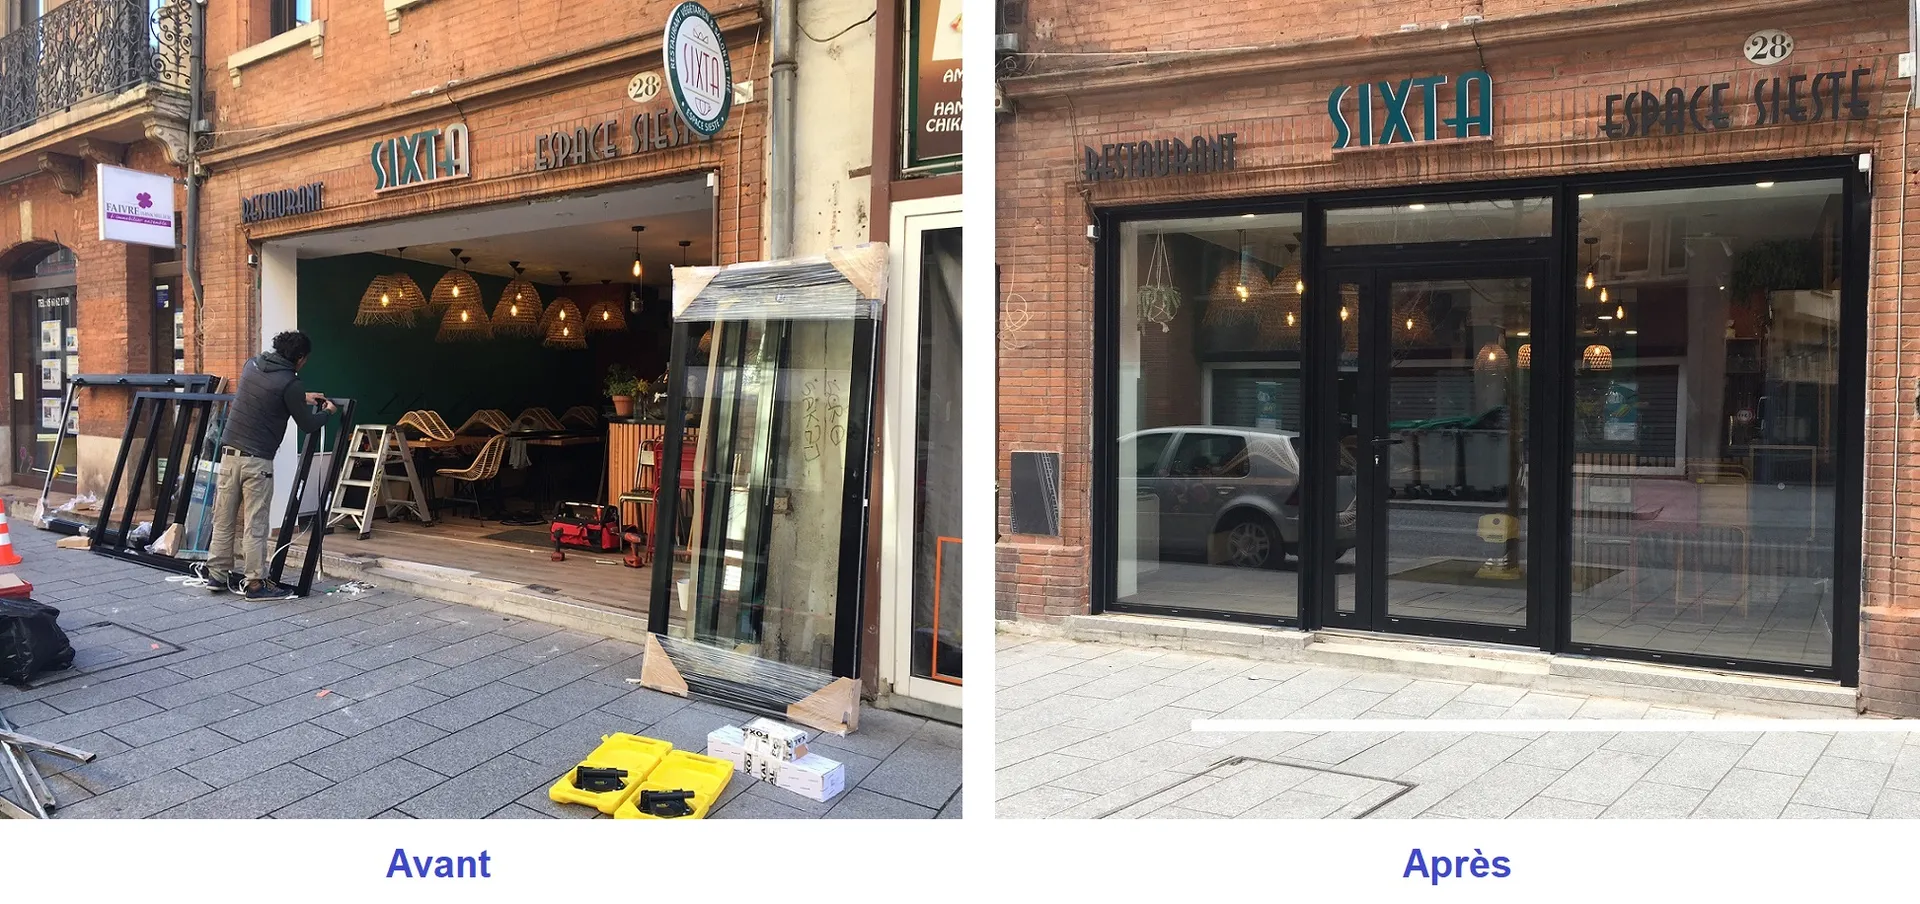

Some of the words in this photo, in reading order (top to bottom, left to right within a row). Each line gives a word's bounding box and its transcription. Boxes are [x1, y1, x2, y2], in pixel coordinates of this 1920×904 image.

[669, 13, 682, 69] RESTAURANT
[1751, 34, 1787, 59] 28
[633, 75, 657, 99] 28
[683, 43, 720, 98] SIXTA
[686, 108, 704, 131] ESPACE
[704, 119, 720, 132] SIESTE
[925, 118, 963, 132] CHIK
[1328, 70, 1493, 148] SIXTA
[1598, 82, 1730, 138] ESPACE
[1754, 68, 1870, 126] SIESTE
[370, 122, 470, 190] SIXTA
[535, 119, 618, 171] ESPACE
[1083, 133, 1238, 181] RESTAURANT
[106, 202, 140, 216] FAIVRE
[241, 181, 324, 224] RESTAURANT
